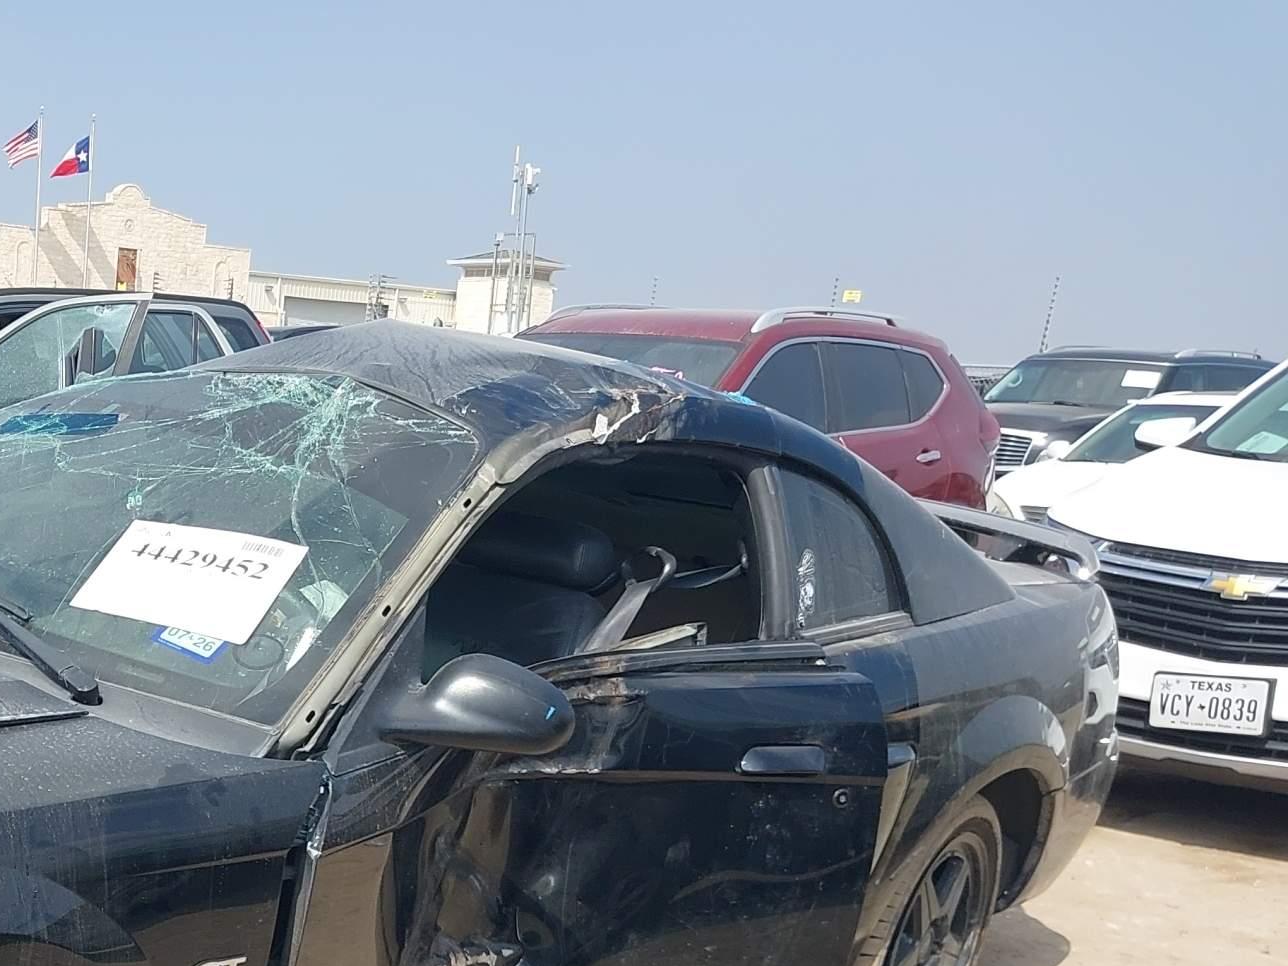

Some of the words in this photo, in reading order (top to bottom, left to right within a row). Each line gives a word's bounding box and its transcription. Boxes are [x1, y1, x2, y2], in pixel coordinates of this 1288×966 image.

[131, 543, 270, 580] 44429452
[192, 637, 216, 652] 26
[1190, 680, 1233, 693] TEXAS
